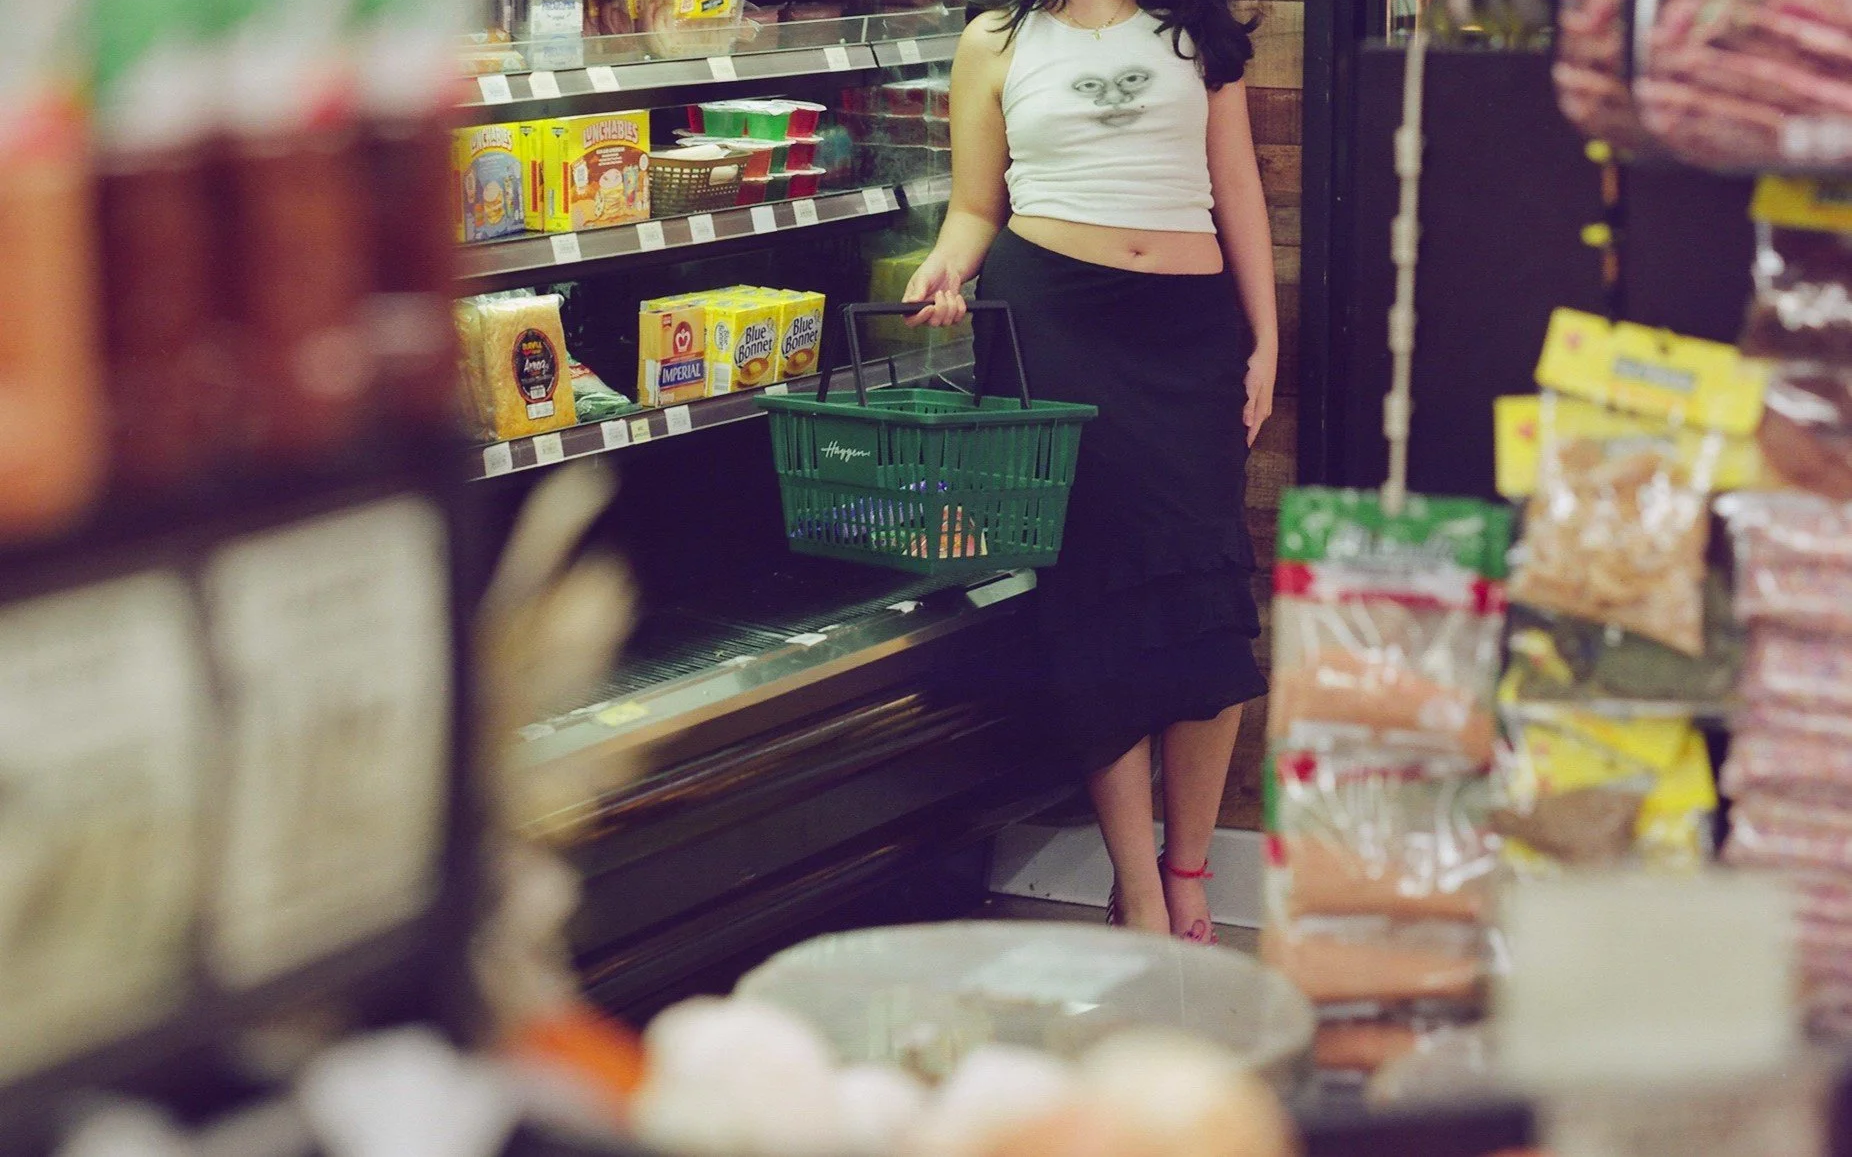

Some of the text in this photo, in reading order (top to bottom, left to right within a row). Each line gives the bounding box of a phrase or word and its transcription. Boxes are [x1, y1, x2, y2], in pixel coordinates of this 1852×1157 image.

[583, 119, 639, 149] LUNCHABLES
[745, 325, 767, 344] Blue
[793, 317, 814, 336] Blue
[738, 338, 773, 364] Bonnet
[786, 329, 818, 354] Bonnet
[662, 362, 701, 384] IMPERIAL
[821, 440, 871, 463] Haggen
